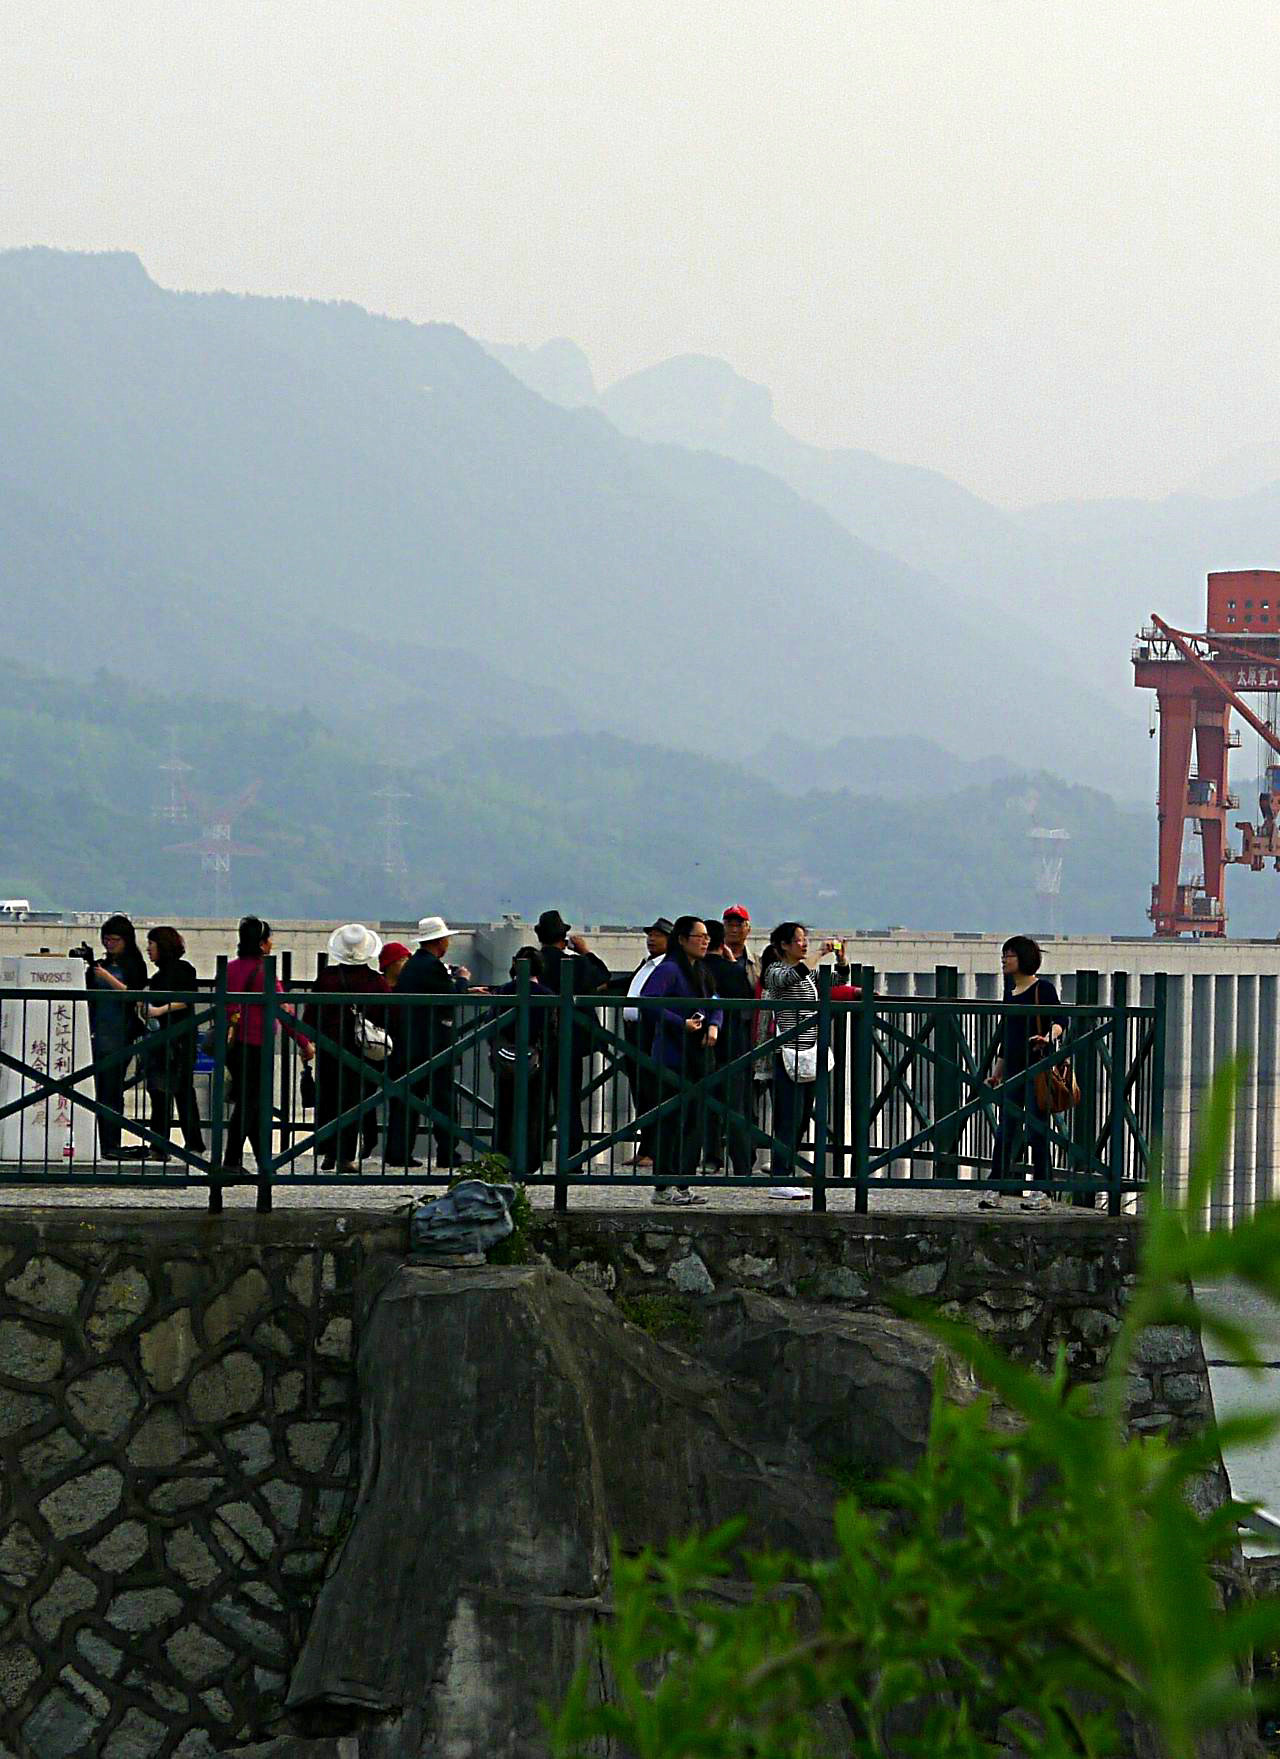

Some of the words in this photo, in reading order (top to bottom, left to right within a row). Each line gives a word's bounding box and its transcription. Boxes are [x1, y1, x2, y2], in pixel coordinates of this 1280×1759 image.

[53, 1004, 72, 1128] 长江水利员会
